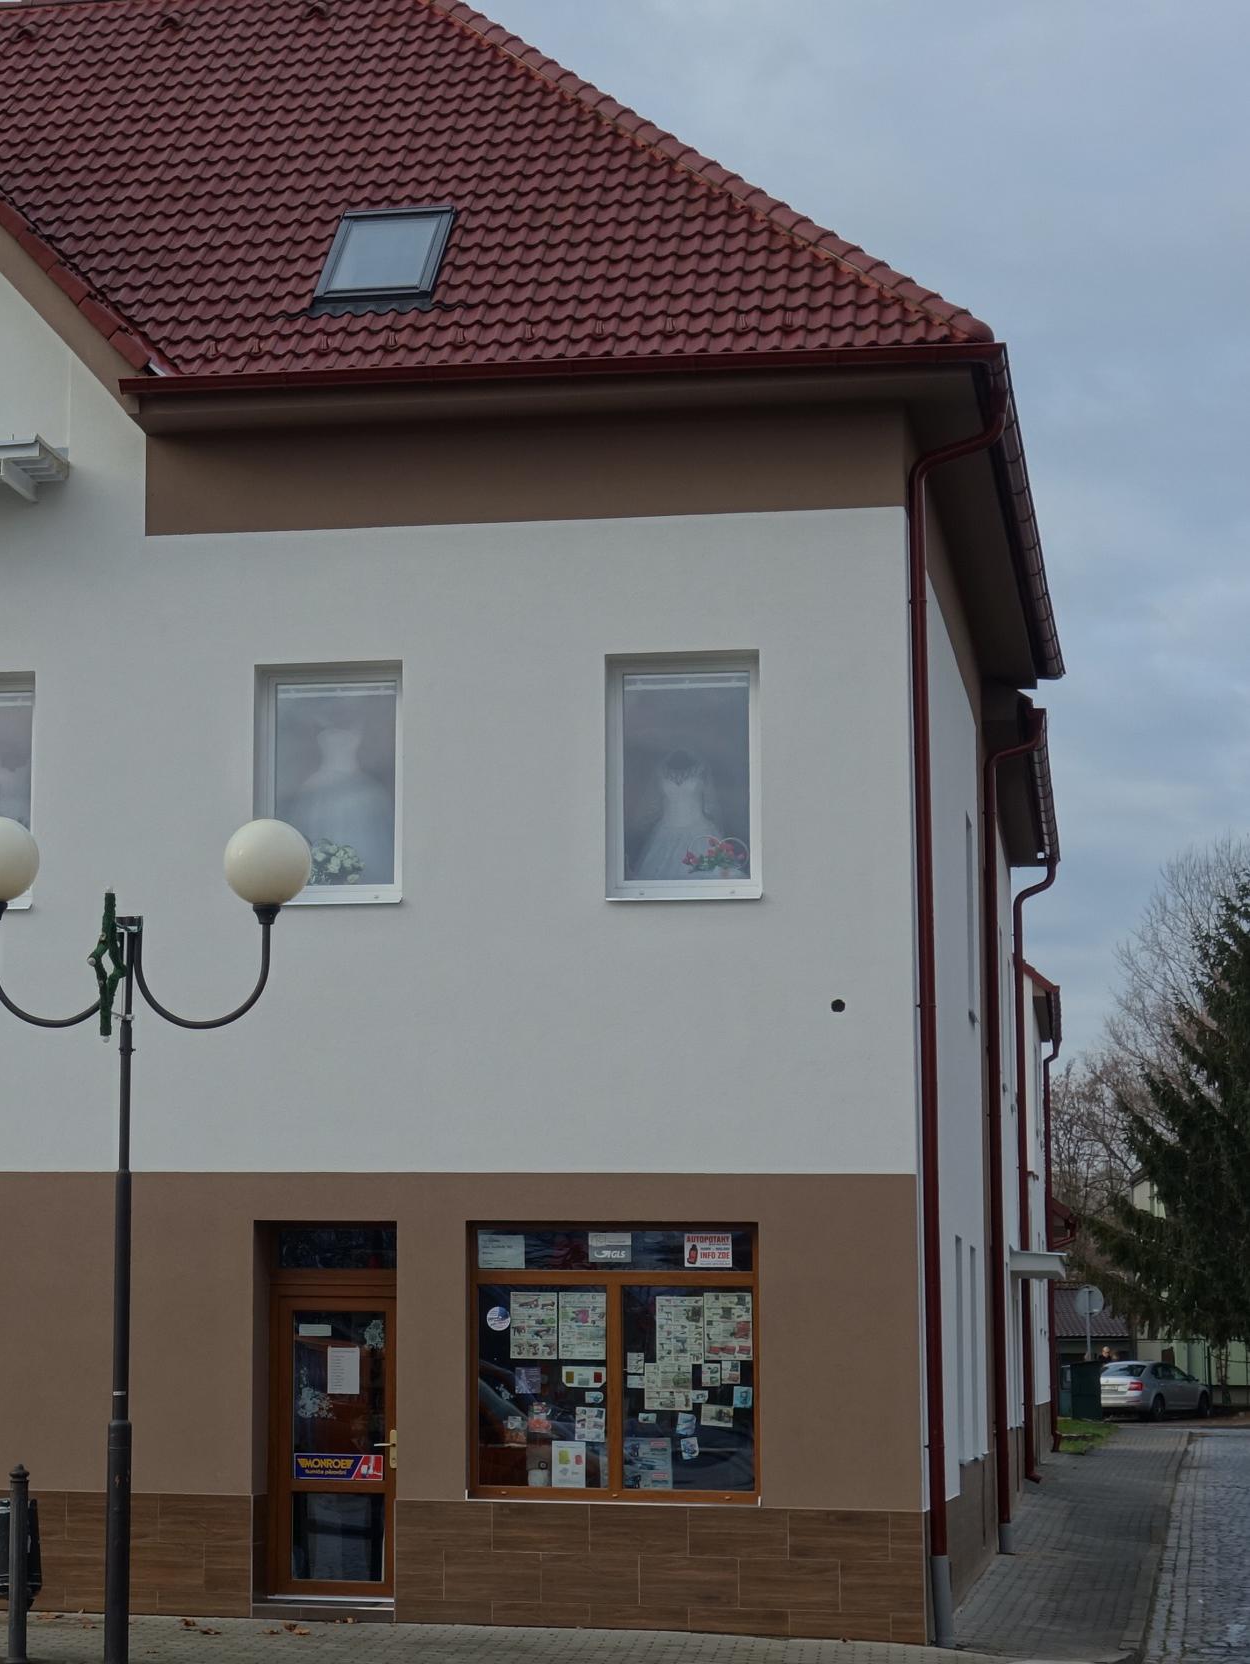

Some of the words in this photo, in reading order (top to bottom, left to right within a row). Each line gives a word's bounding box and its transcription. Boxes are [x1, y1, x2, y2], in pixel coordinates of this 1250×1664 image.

[686, 1235, 730, 1243] AUTOPOTAHY
[612, 1250, 626, 1258] GLS
[297, 1458, 354, 1469] MONROE
